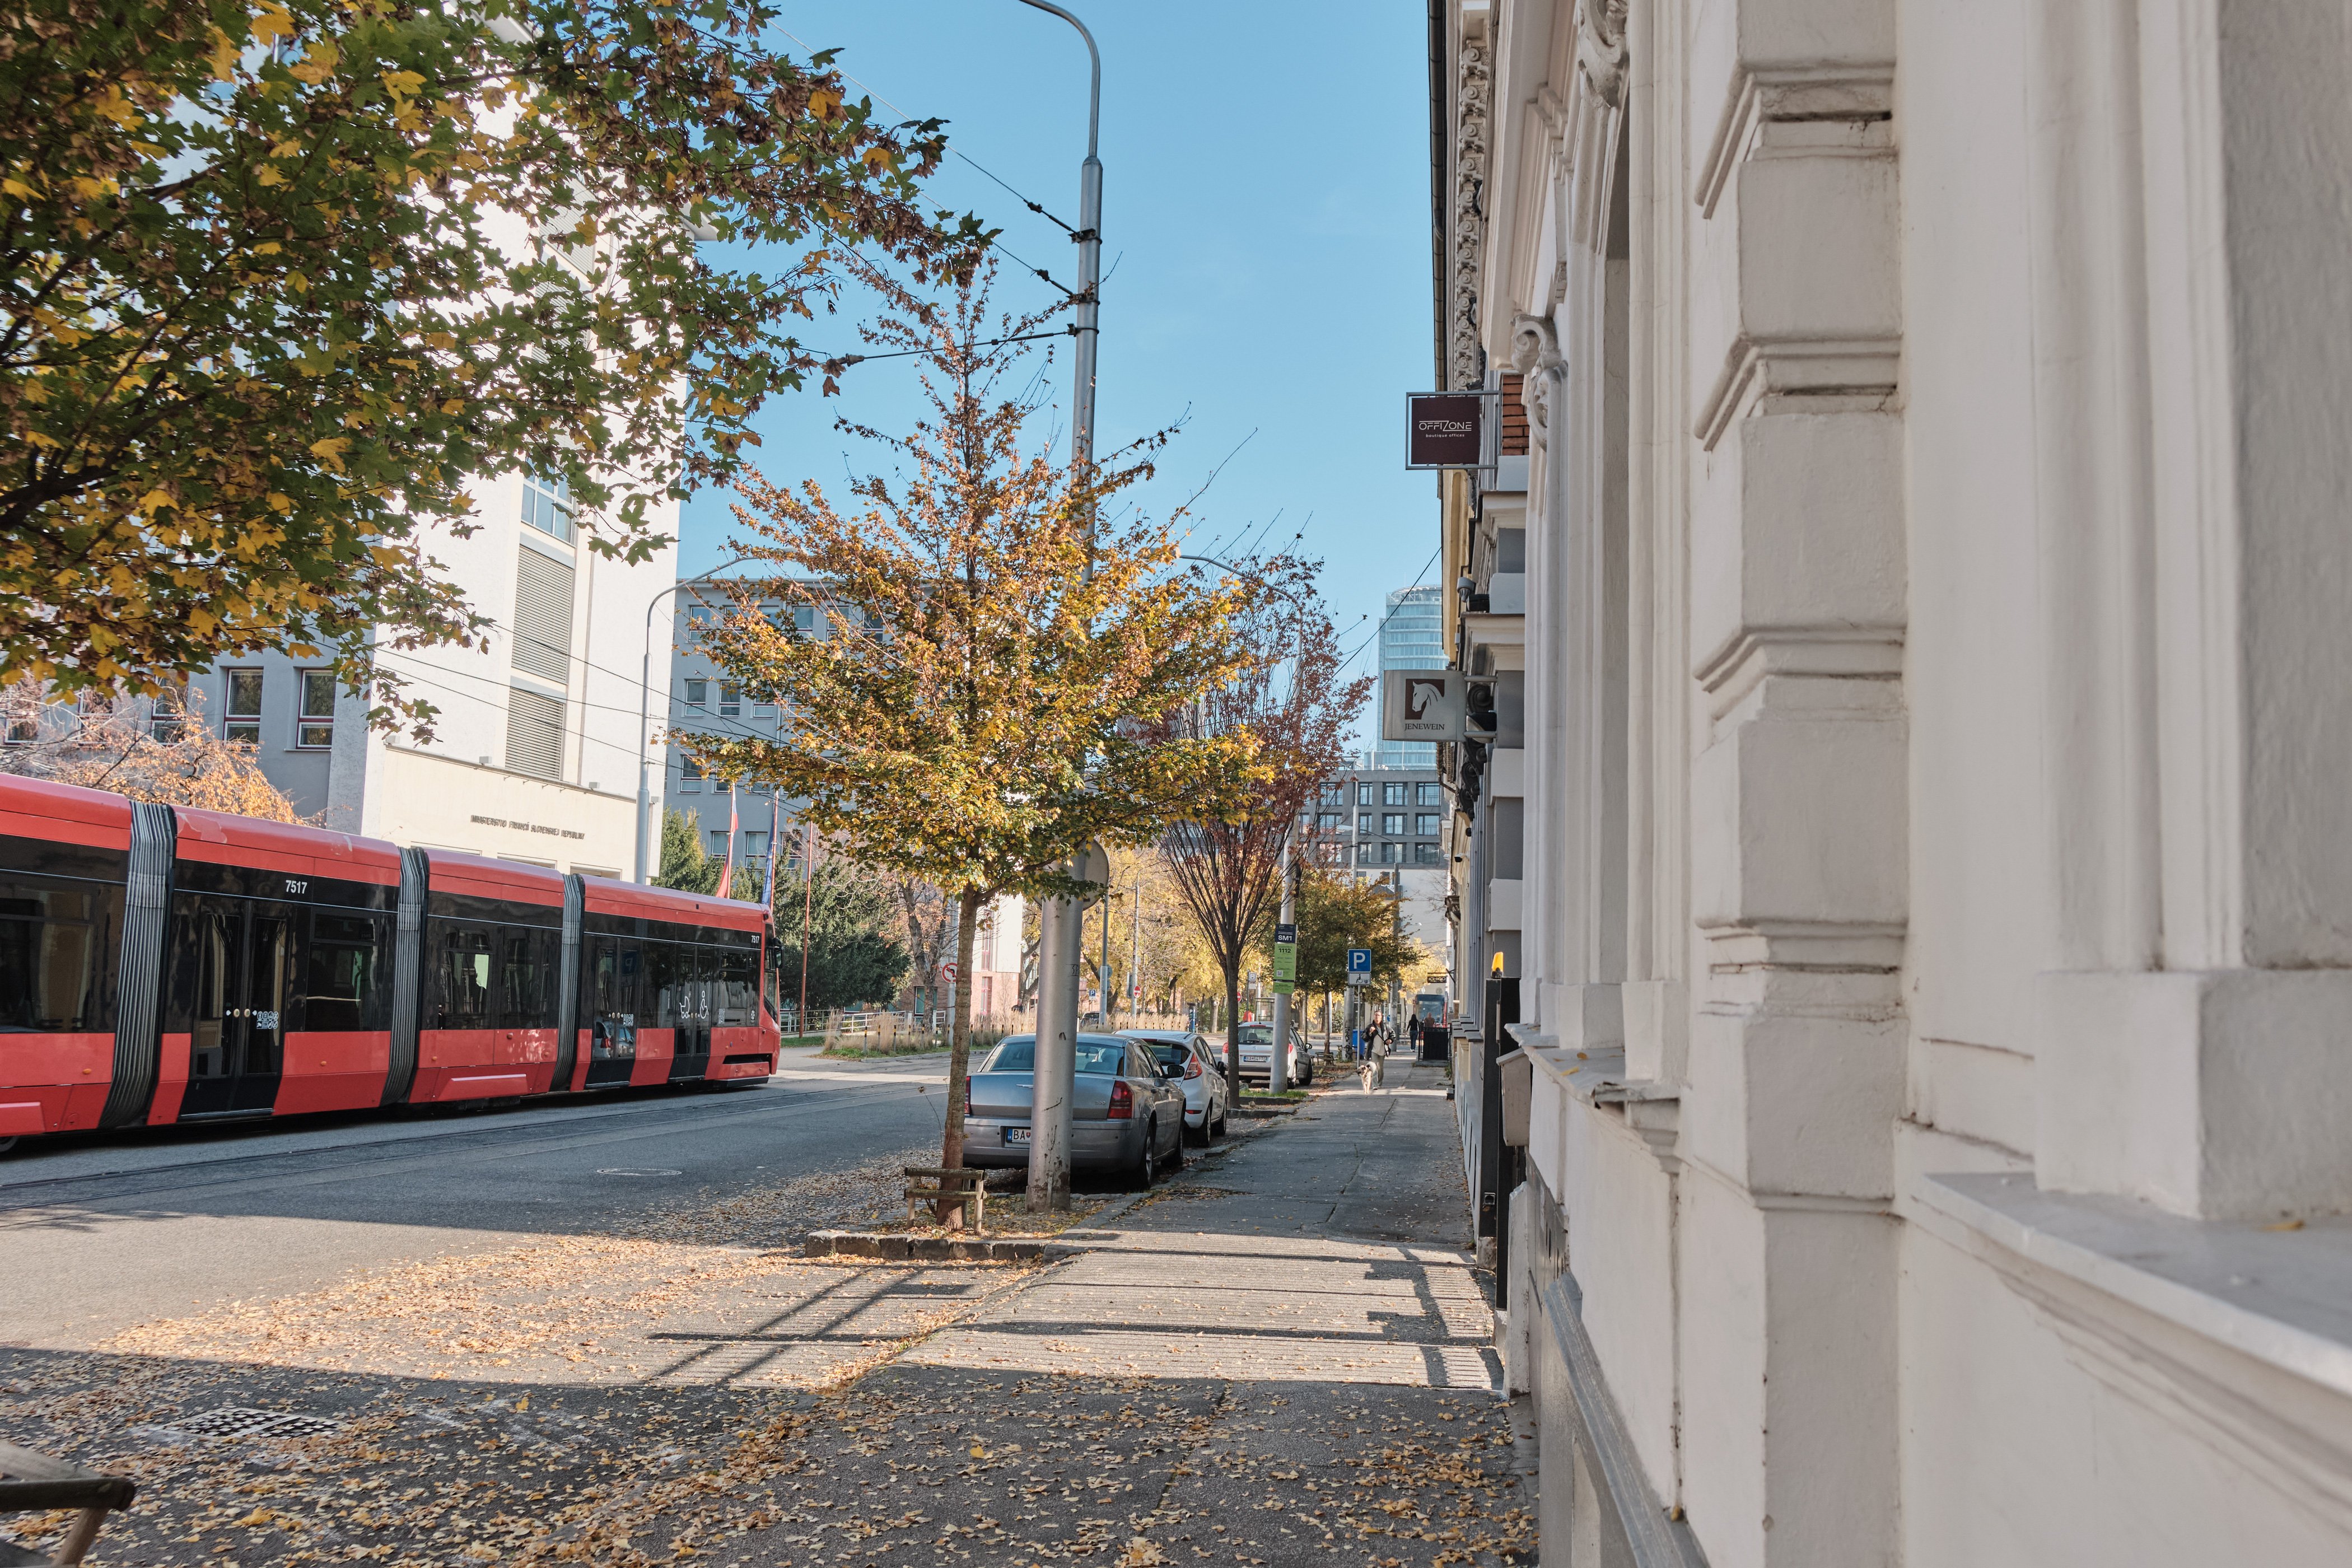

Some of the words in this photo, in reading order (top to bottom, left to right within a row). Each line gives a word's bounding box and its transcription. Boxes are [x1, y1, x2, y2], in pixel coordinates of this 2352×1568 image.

[286, 879, 307, 894] 7517
[751, 935, 759, 944] 7517
[1354, 953, 1366, 969] P
[1014, 1130, 1025, 1140] BA
